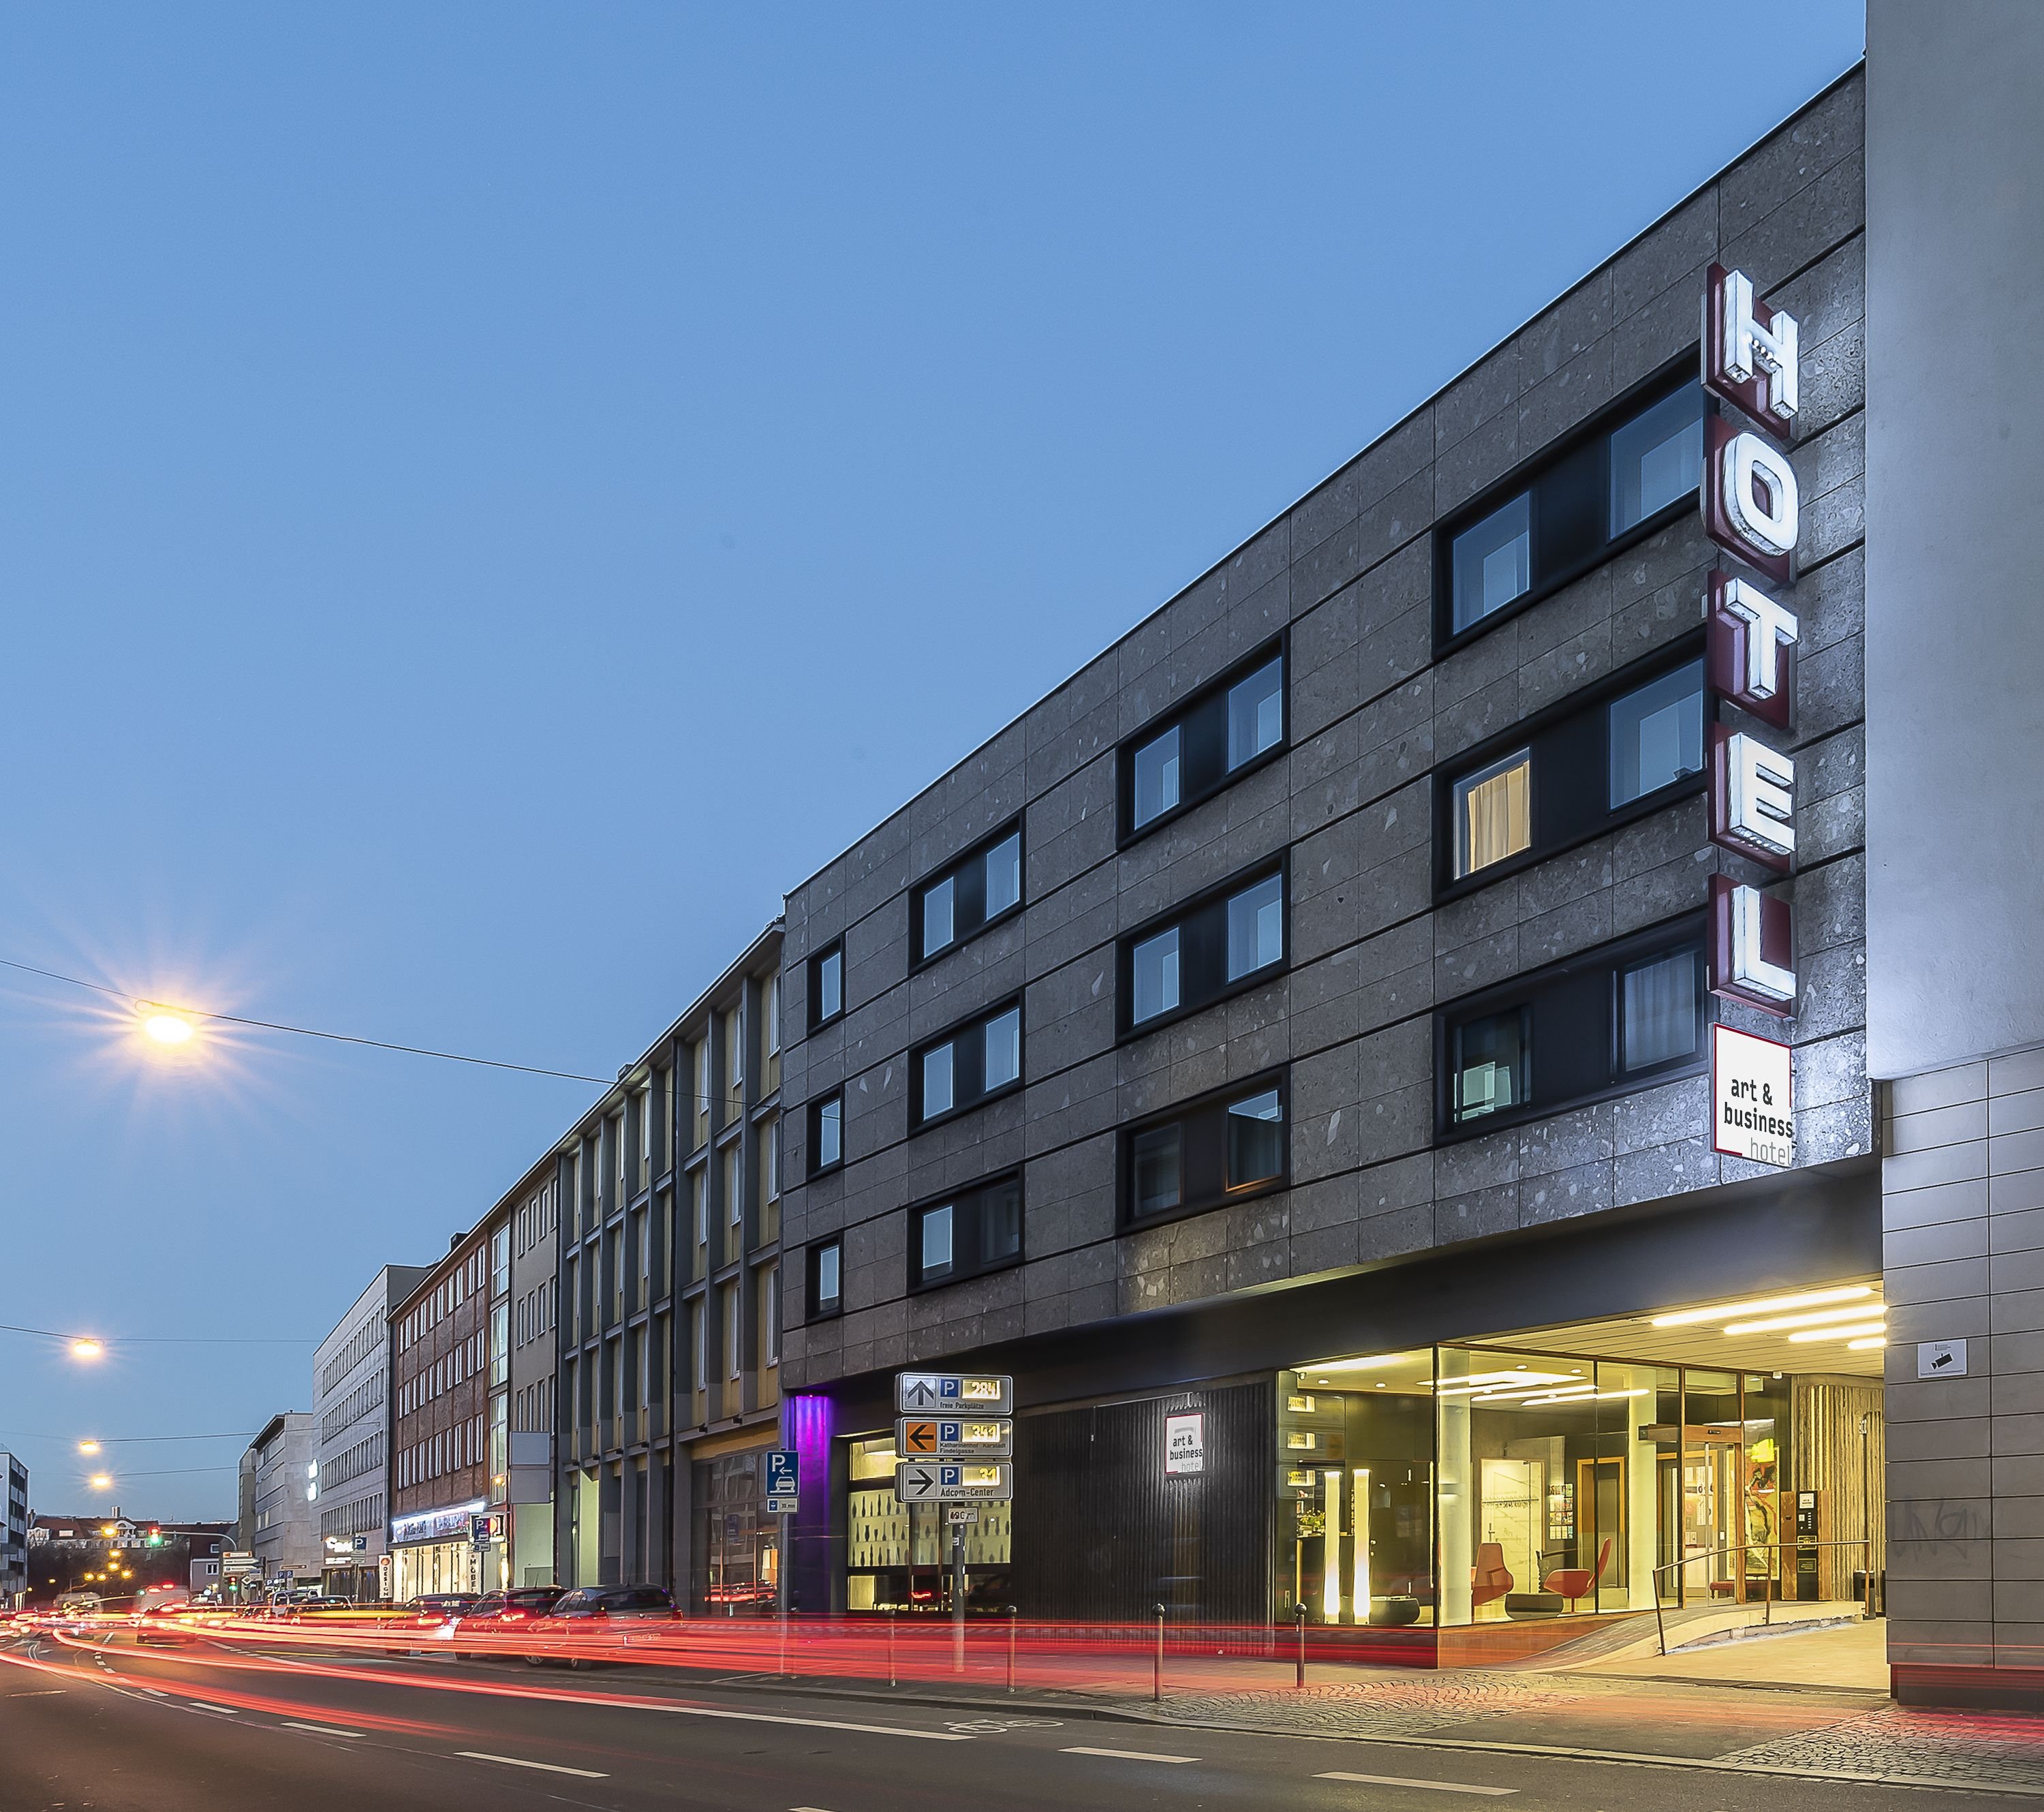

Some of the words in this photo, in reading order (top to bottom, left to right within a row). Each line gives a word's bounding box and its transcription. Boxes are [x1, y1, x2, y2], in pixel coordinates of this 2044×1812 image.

[1722, 268, 1799, 1002] HOTEL
[1731, 1079, 1757, 1101] art
[1763, 1083, 1773, 1105] &
[1724, 1101, 1793, 1138] business
[1750, 1137, 1792, 1166] hotel
[944, 1382, 955, 1395] P
[955, 1402, 985, 1410] Parkplätze
[944, 1426, 955, 1439] P
[1173, 1435, 1186, 1447] art
[1188, 1434, 1193, 1445] &
[1170, 1448, 1203, 1460] business
[772, 1454, 786, 1472] P
[1181, 1460, 1203, 1472] hotel
[944, 1469, 955, 1484] P
[940, 1488, 994, 1497] Adcom-Center
